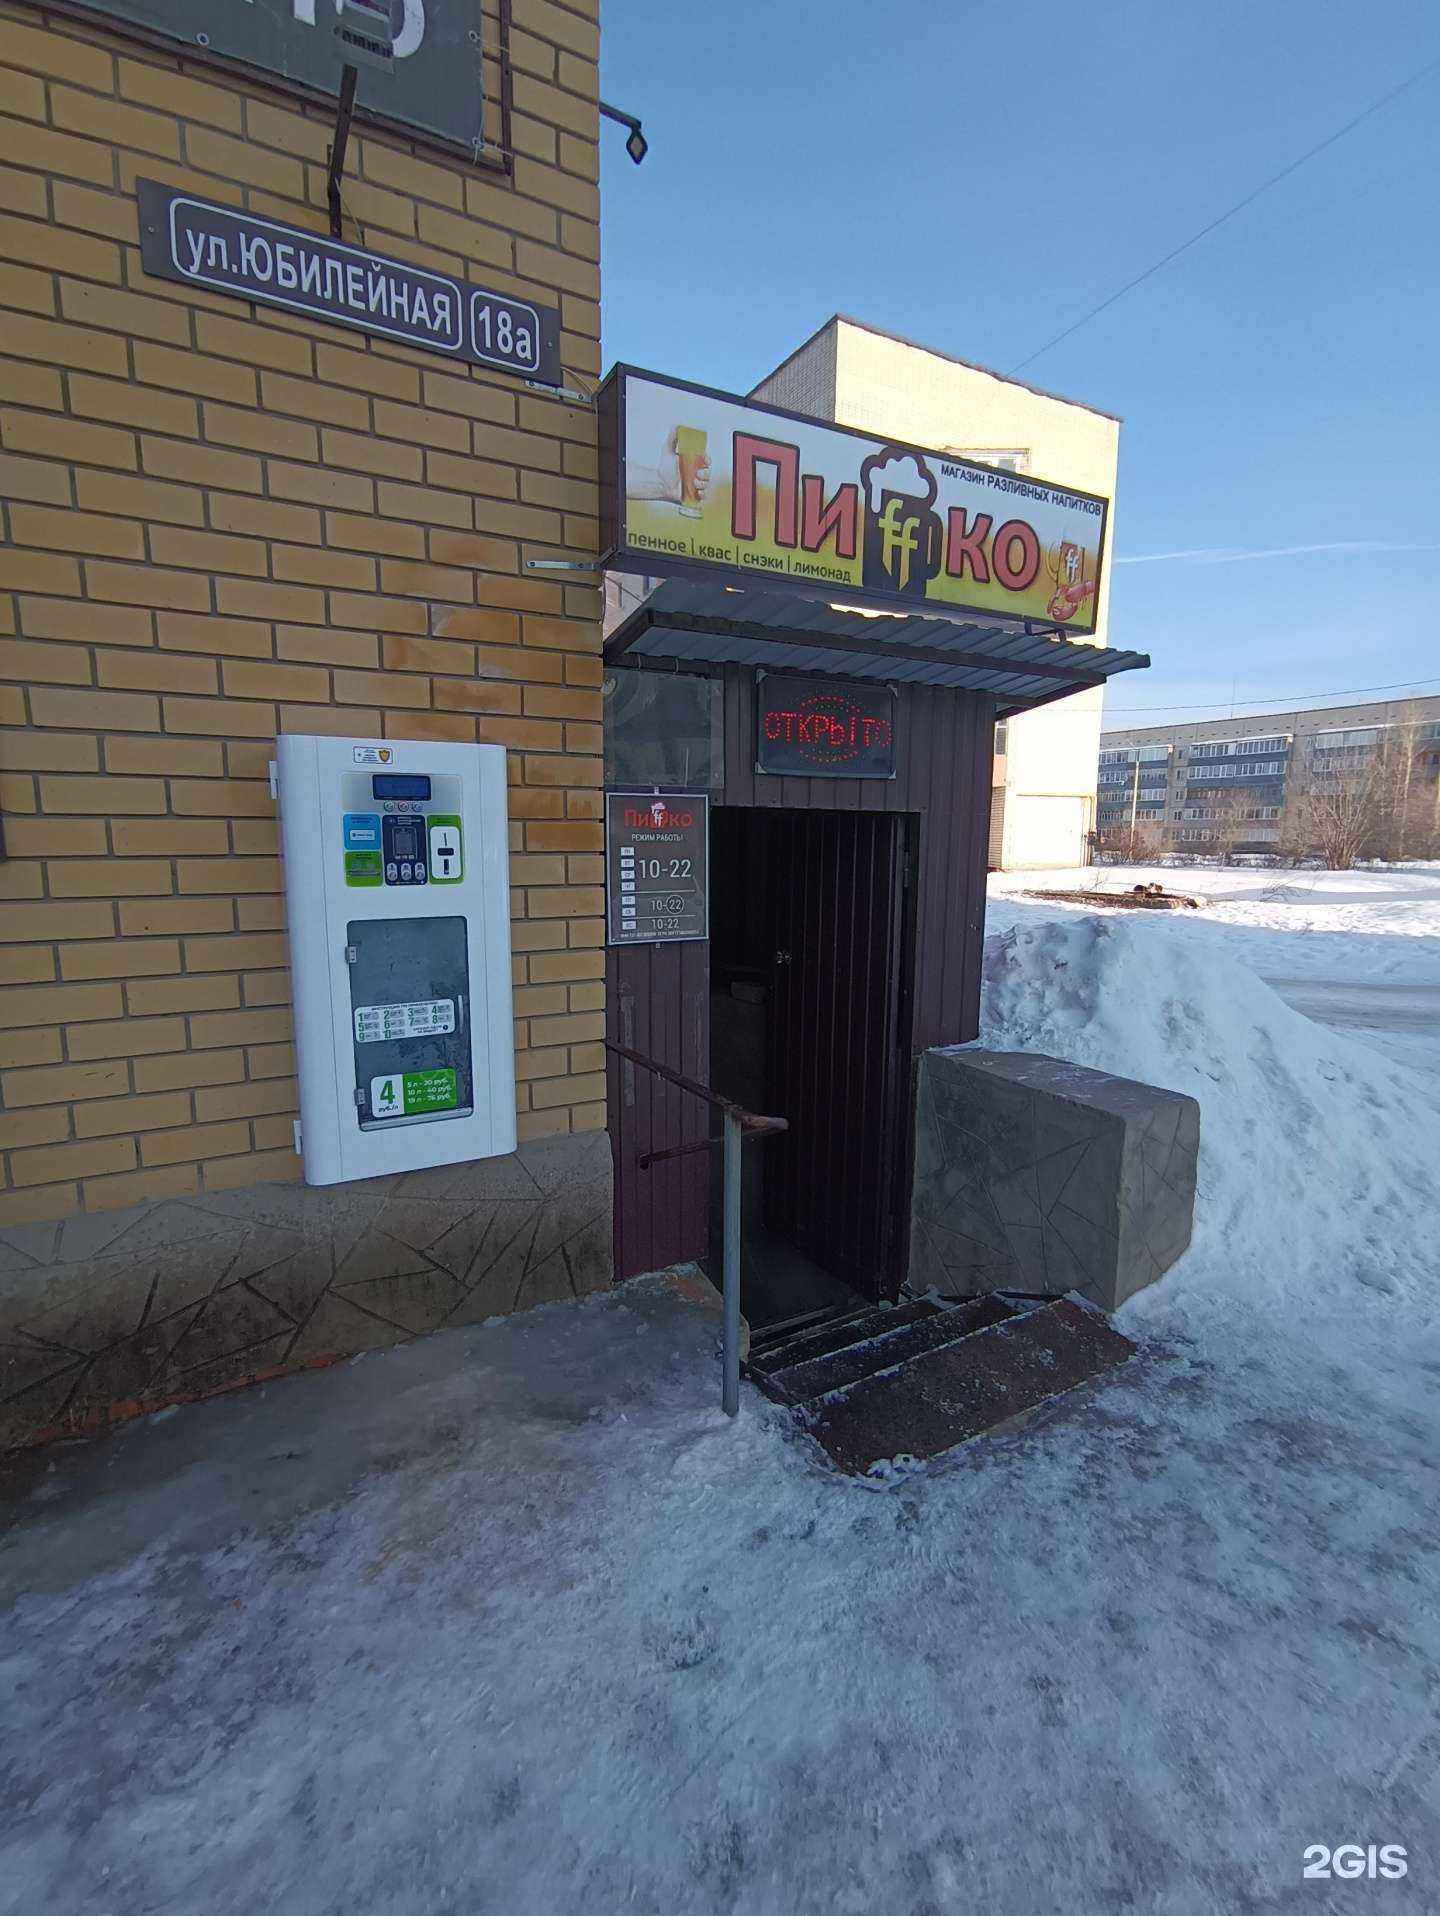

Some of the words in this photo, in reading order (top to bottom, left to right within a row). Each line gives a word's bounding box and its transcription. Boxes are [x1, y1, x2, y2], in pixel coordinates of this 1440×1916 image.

[478, 305, 533, 360] 18а
[941, 463, 985, 485] МАГАЗИН
[987, 474, 1050, 502] РАЗЛИВНЫХ
[1051, 494, 1102, 516] НАПИТКОВ
[627, 532, 687, 553] пенное
[699, 545, 732, 561] квас
[743, 552, 784, 570] снэки
[793, 562, 852, 583] лимонад
[631, 833, 656, 842] РЕЖИМ
[656, 833, 683, 842] РАБОТЫ
[638, 859, 692, 879] 10-22
[651, 918, 680, 930] 10-22
[380, 1080, 396, 1105] 4
